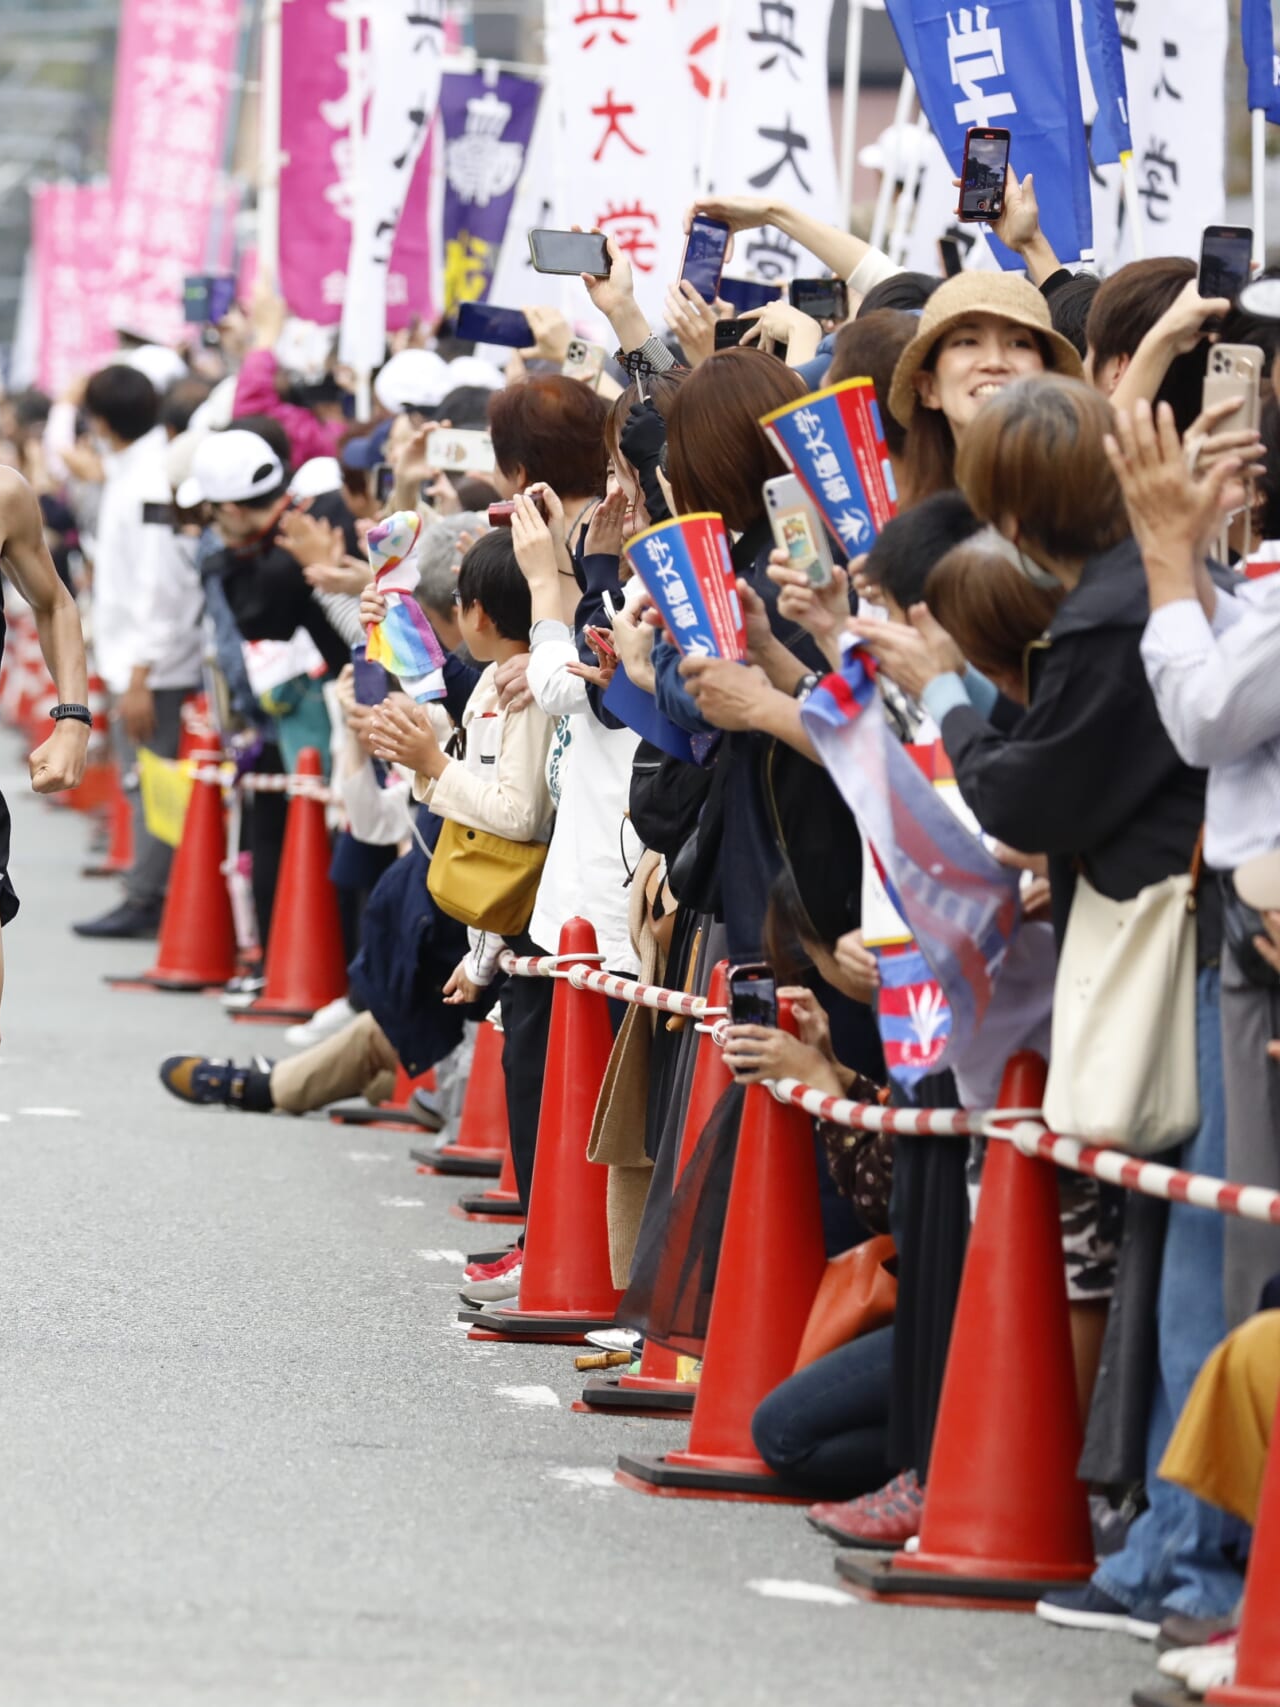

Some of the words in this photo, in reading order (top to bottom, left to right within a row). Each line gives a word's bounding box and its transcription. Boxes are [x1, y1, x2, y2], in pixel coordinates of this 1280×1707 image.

[792, 407, 852, 503] 創価大学
[644, 536, 698, 630] 創価大学
